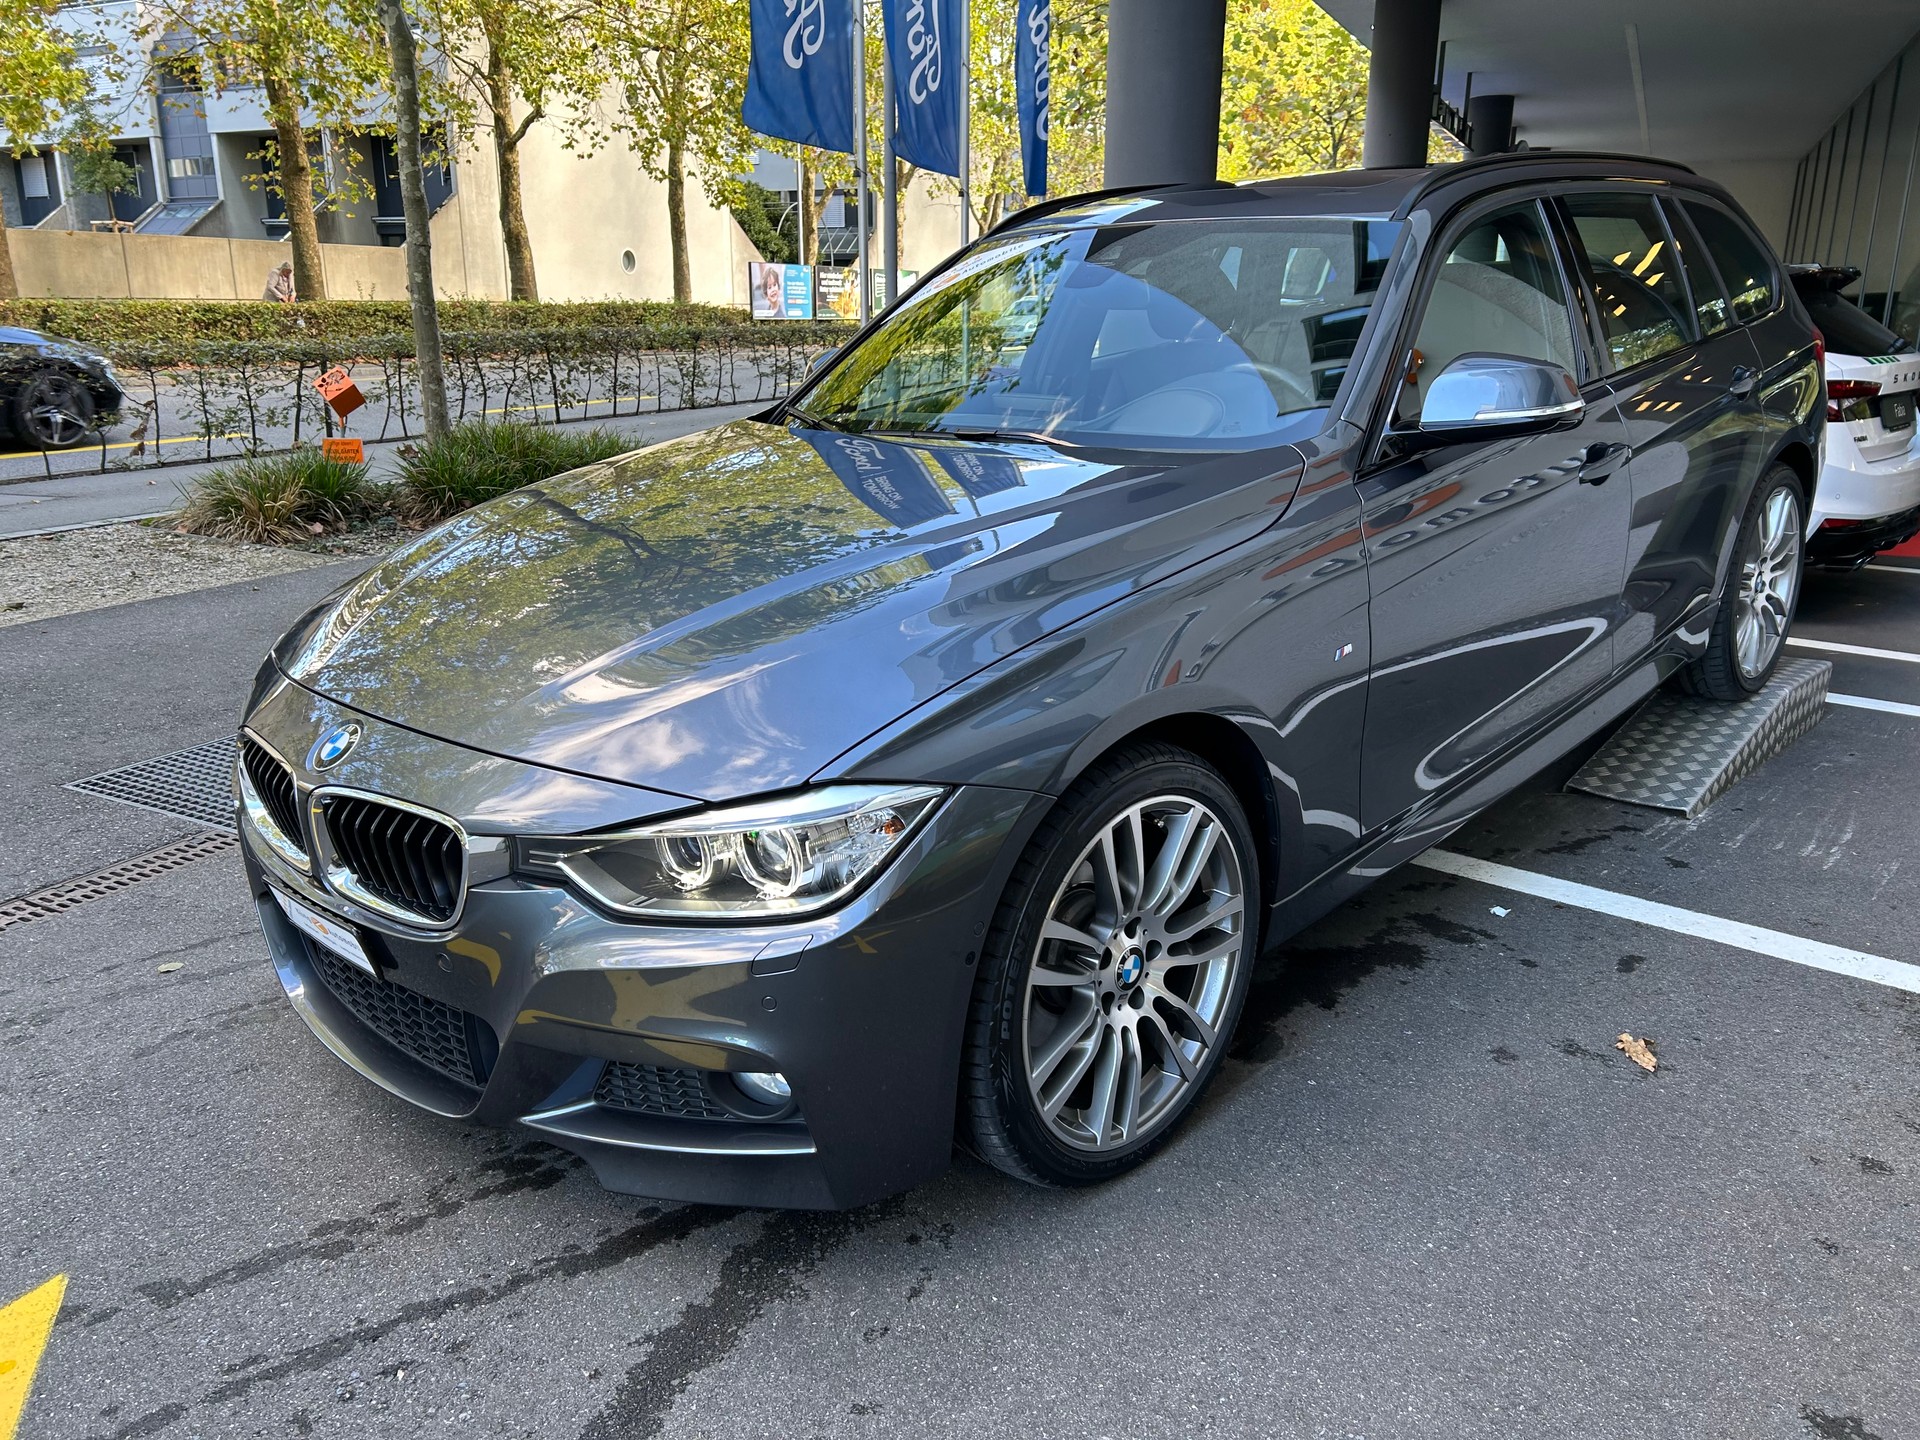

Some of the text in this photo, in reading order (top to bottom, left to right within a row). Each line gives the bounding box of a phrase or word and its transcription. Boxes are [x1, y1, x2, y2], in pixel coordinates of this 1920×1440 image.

[835, 438, 885, 472] Ford
[861, 478, 900, 509] TOMORROW
[874, 475, 903, 503] BRING ON
[1117, 949, 1132, 988] BMW
